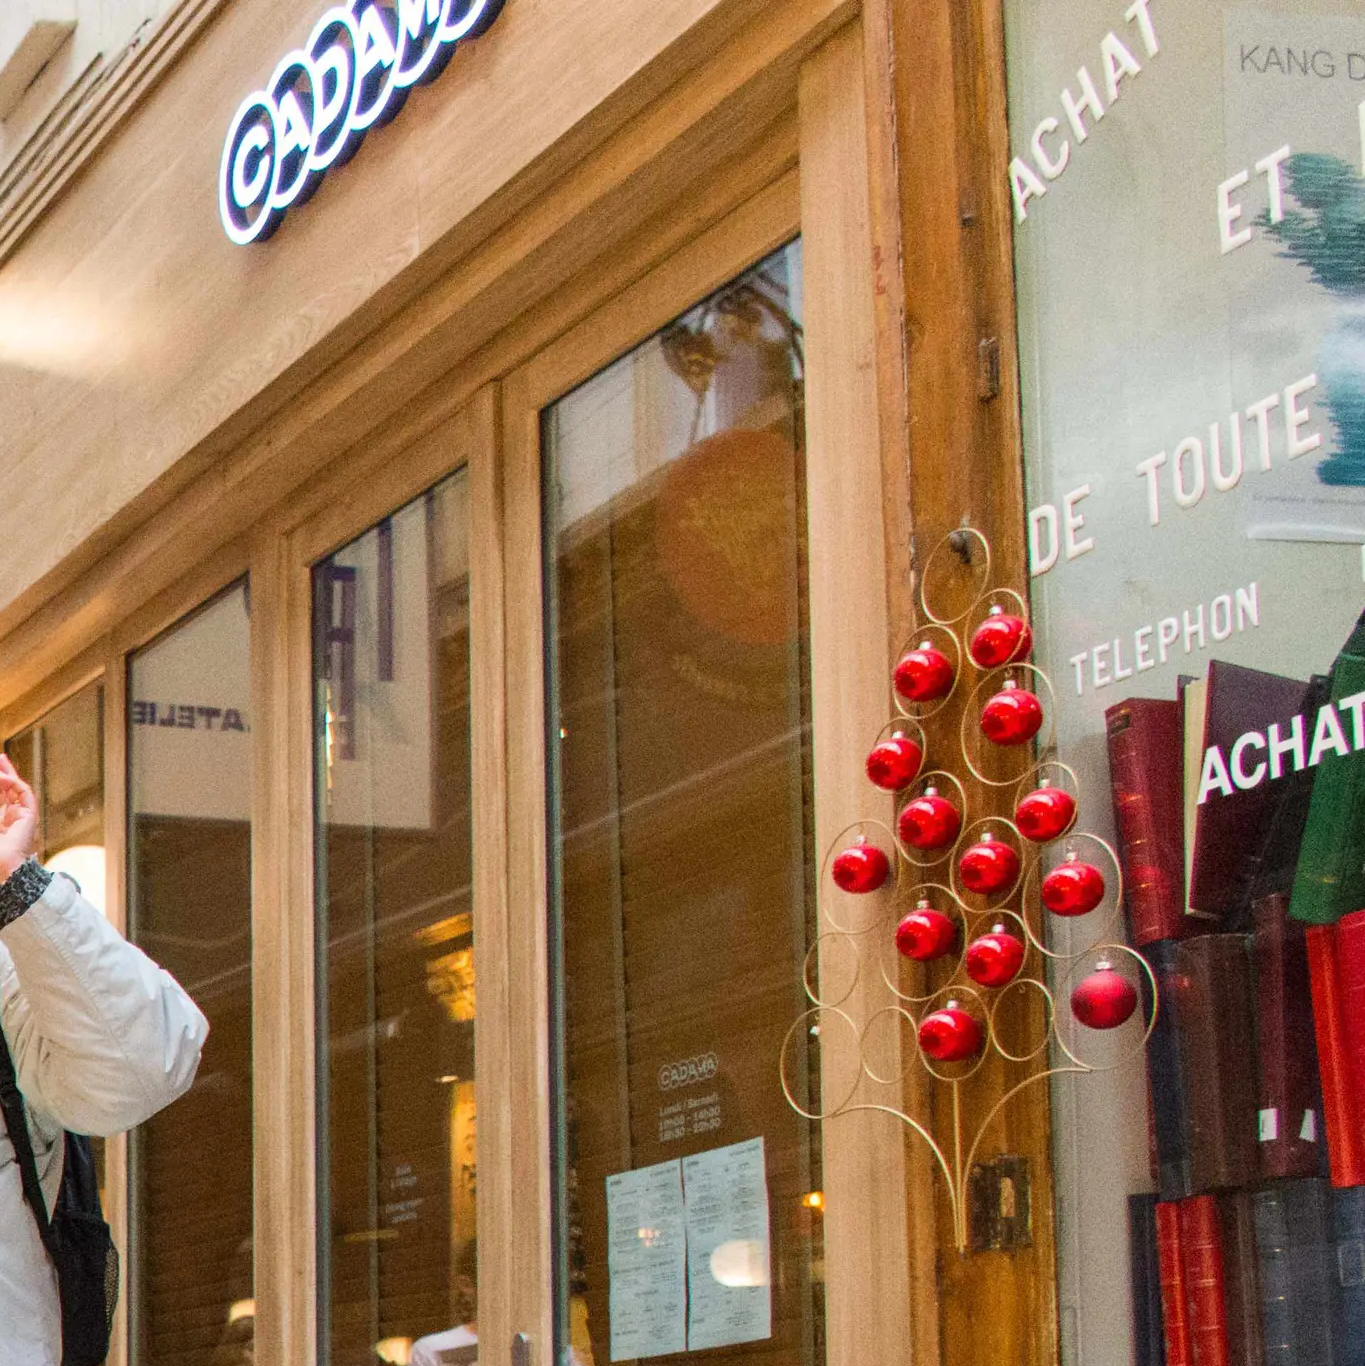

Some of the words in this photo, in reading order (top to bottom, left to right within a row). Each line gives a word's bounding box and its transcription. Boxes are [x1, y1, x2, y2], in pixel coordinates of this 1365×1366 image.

[1008, 0, 1159, 225] ACHAT
[1239, 44, 1335, 78] KANG
[1218, 145, 1290, 255] ET
[1029, 484, 1095, 578] DE
[1136, 374, 1322, 526] TOUTE
[1070, 582, 1260, 696] TELEPHON
[1197, 690, 1365, 806] ACHAT
